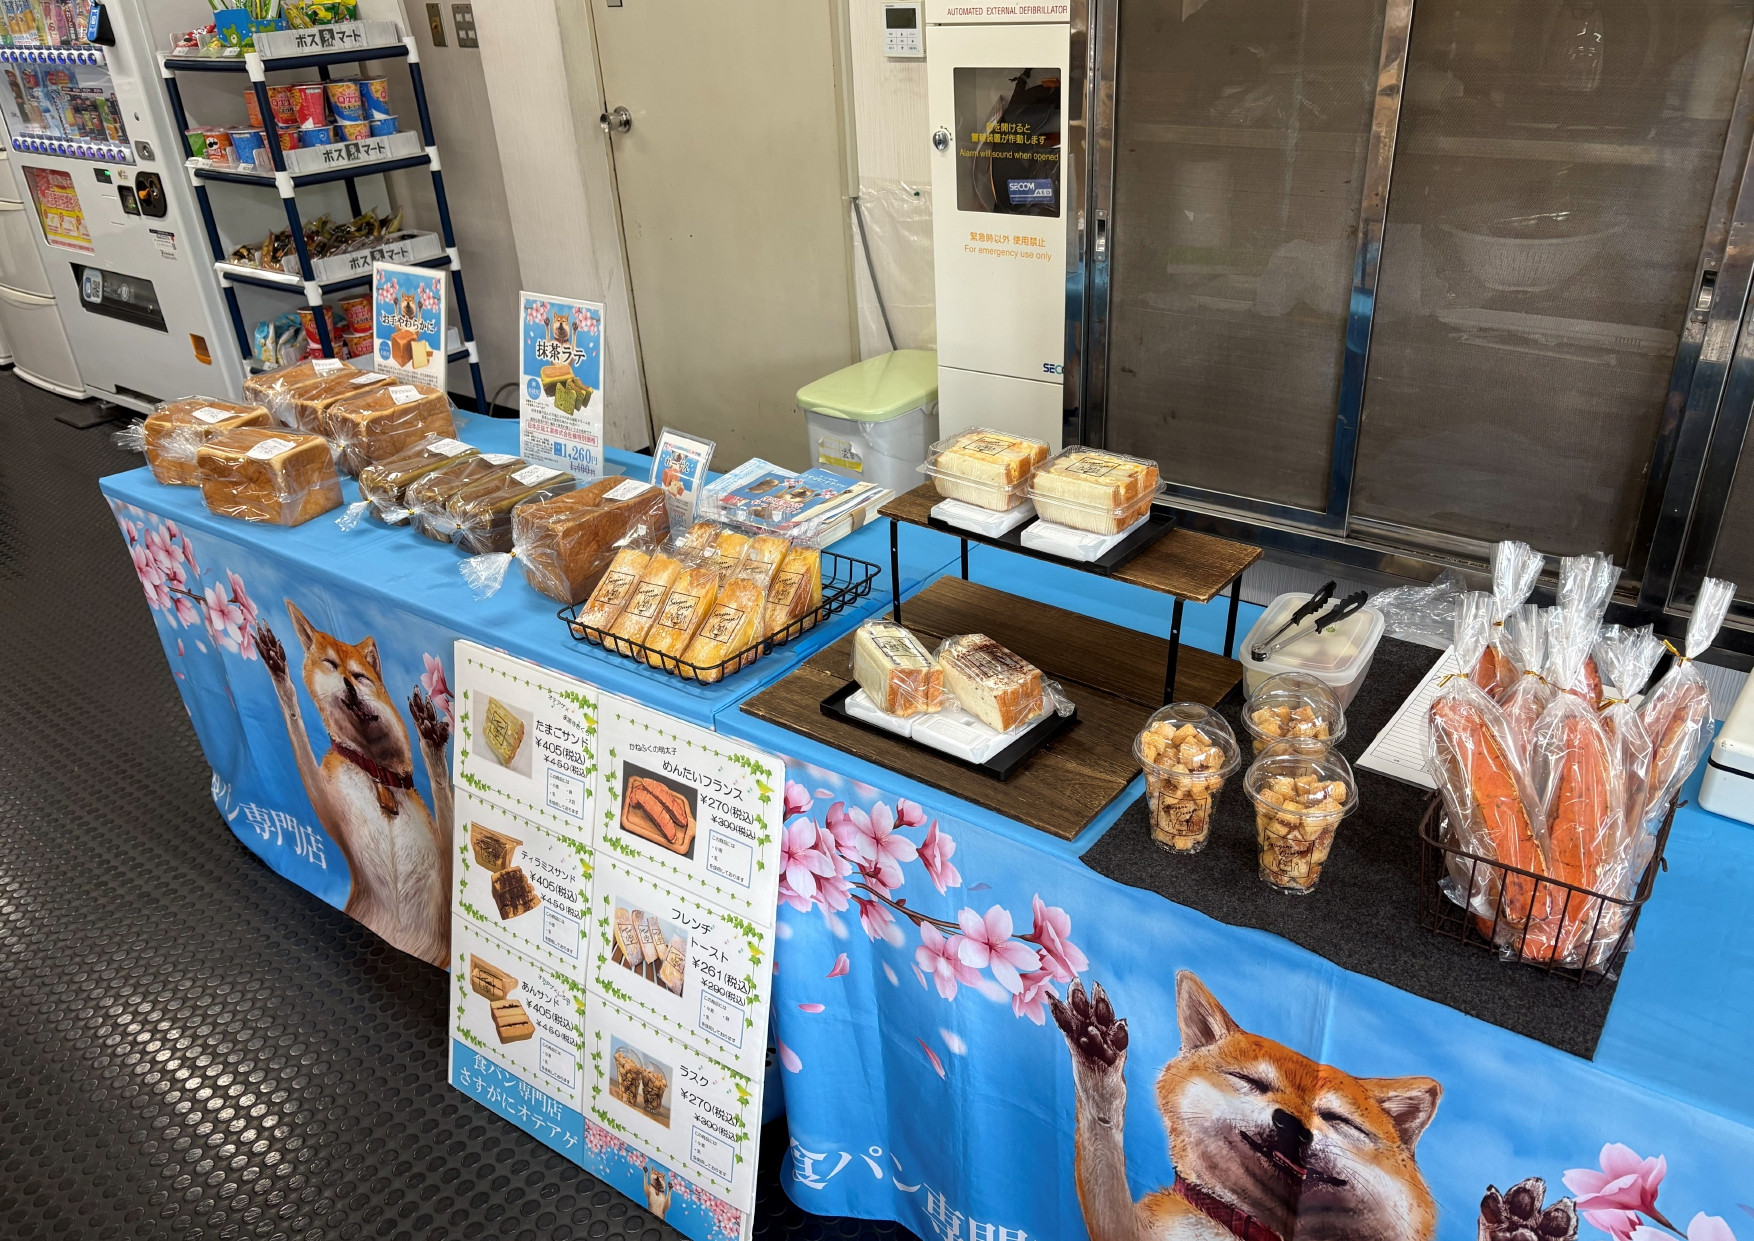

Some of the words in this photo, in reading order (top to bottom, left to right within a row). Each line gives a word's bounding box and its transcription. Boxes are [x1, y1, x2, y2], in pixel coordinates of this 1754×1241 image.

[947, 7, 983, 16] AUTOMATED
[986, 6, 1018, 15] EXTERNAL
[1018, 5, 1068, 15] DEFIBRILLATOR
[295, 33, 319, 49] ボス
[335, 29, 361, 44] マート
[322, 147, 345, 164] ボス
[361, 141, 386, 158] マート
[959, 148, 979, 158] Alarm
[980, 149, 991, 159] will
[992, 150, 1013, 159] sound
[1014, 151, 1032, 160] when
[1033, 152, 1059, 162] opened
[1009, 182, 1035, 191] SECOM
[969, 231, 1010, 245] 緊急時以外
[1013, 235, 1046, 248] 使用禁止
[349, 255, 370, 270] ボス
[386, 246, 408, 261] マート
[964, 244, 976, 254] For
[978, 246, 1018, 259] emergency
[1020, 250, 1034, 259] use
[1036, 251, 1052, 262] only
[382, 314, 435, 334] お手やわらかに
[536, 339, 586, 366] 抹茶ラテ
[535, 720, 589, 749] たまごサンド
[629, 743, 678, 756] かねふくの明太子
[662, 760, 744, 802] めんたいフランス
[521, 850, 576, 884] ティラミスサンド
[671, 907, 712, 935] フレンチ
[690, 936, 729, 963] トースト
[521, 981, 560, 1007] あんサンド
[473, 1053, 563, 1121] 食パン専門店
[680, 1064, 709, 1087] ラスク
[460, 1066, 578, 1149] さすがにオテアゲ
